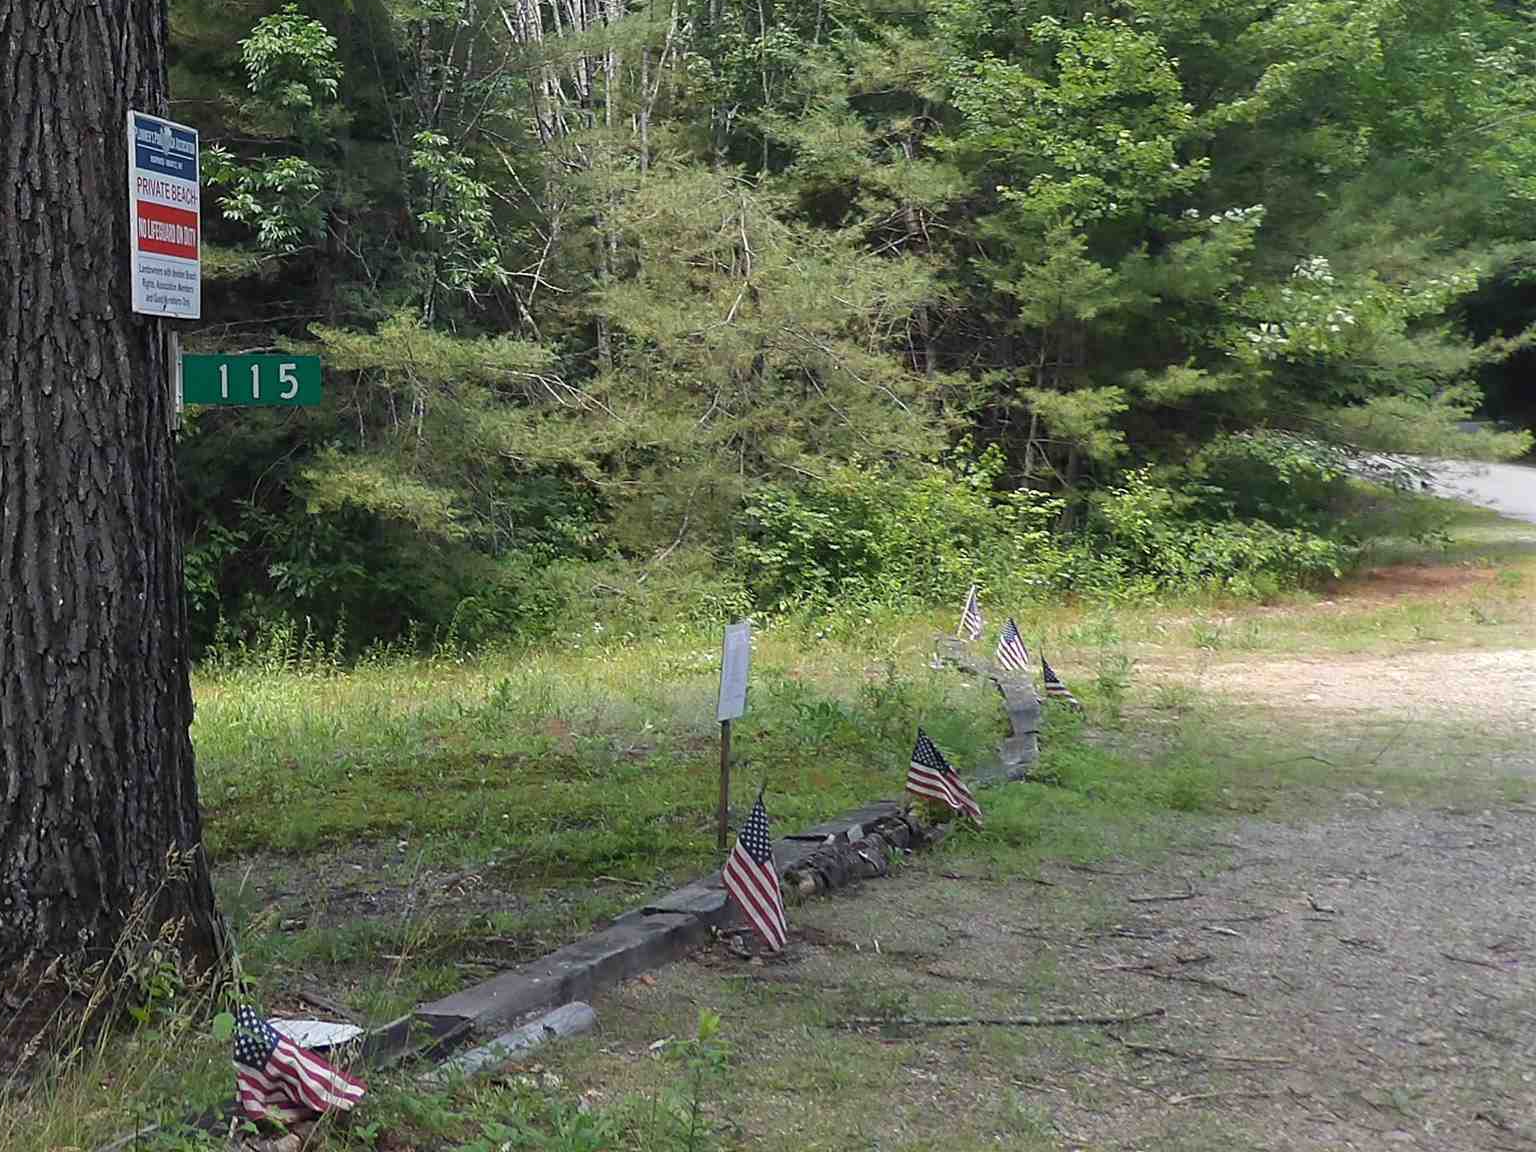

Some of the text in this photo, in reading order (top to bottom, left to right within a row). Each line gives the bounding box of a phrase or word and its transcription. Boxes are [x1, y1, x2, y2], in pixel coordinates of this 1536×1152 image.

[137, 177, 197, 206] PRIVATE BEACH
[138, 217, 196, 248] NO LIFEGUARD ON DUTY
[219, 363, 298, 399] 115
